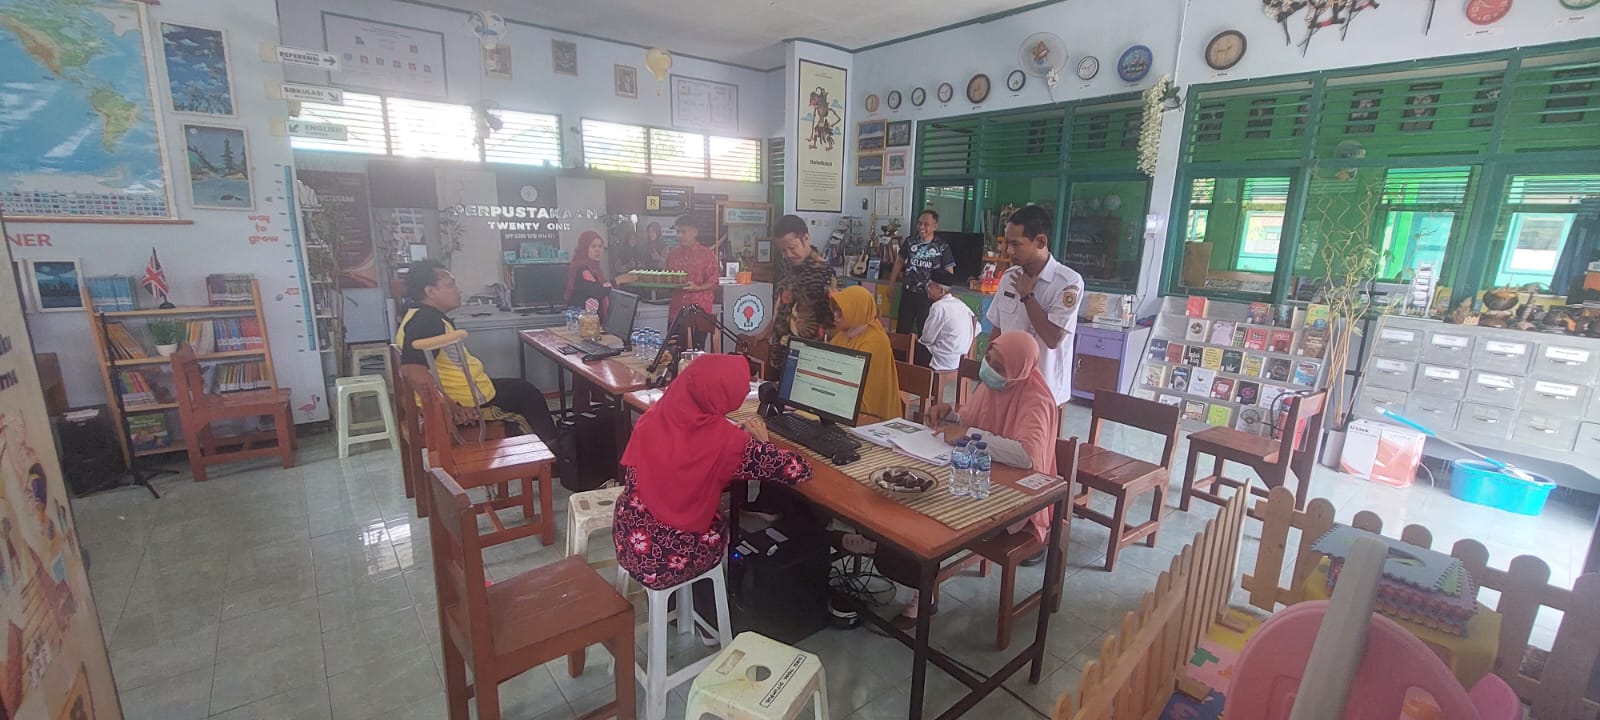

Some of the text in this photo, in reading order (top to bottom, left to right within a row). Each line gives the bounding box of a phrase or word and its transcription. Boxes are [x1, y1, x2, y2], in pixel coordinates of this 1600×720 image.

[650, 198, 657, 207] R
[454, 204, 598, 219] PERPUSTAKAAN
[248, 215, 270, 224] way
[255, 223, 267, 233] to
[488, 221, 570, 231] TWENTY ONE
[248, 234, 279, 245] grow
